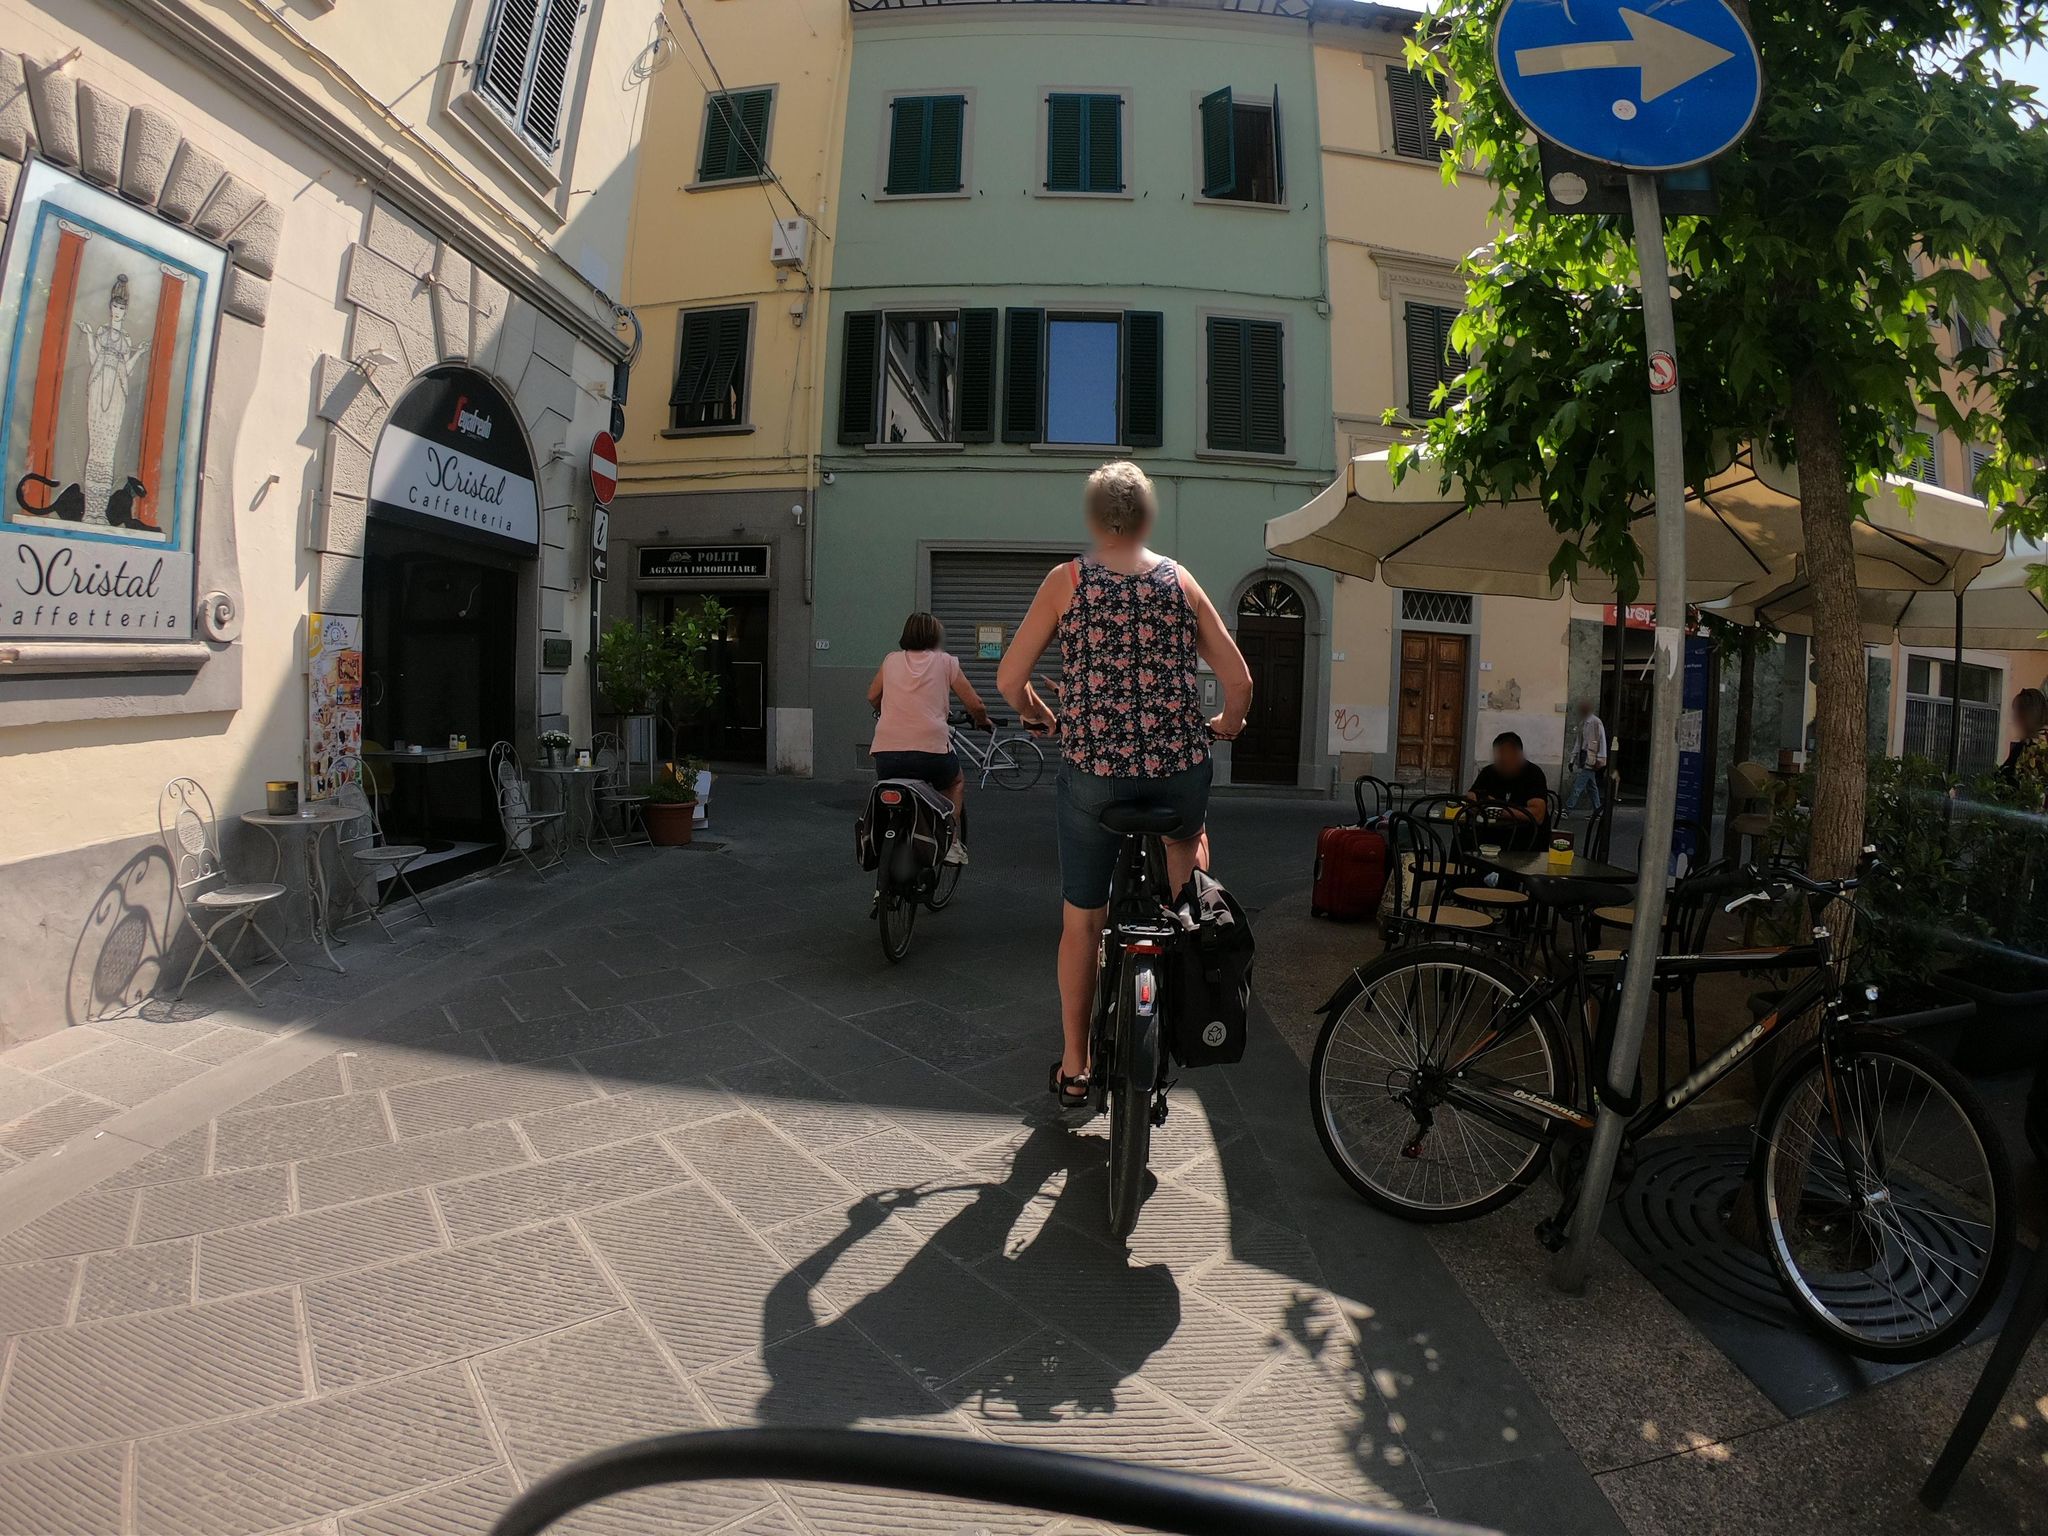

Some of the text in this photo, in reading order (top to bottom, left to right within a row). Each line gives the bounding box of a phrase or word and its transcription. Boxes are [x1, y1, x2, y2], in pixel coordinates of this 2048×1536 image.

[447, 395, 493, 439] Segafredo
[408, 485, 512, 532] Caffetteria
[649, 565, 757, 574] AGENZIA IMMOBILIARE
[697, 551, 740, 562] POLITI
[0, 604, 176, 628] affetteria
[1513, 1089, 1582, 1121] Orizzonte
